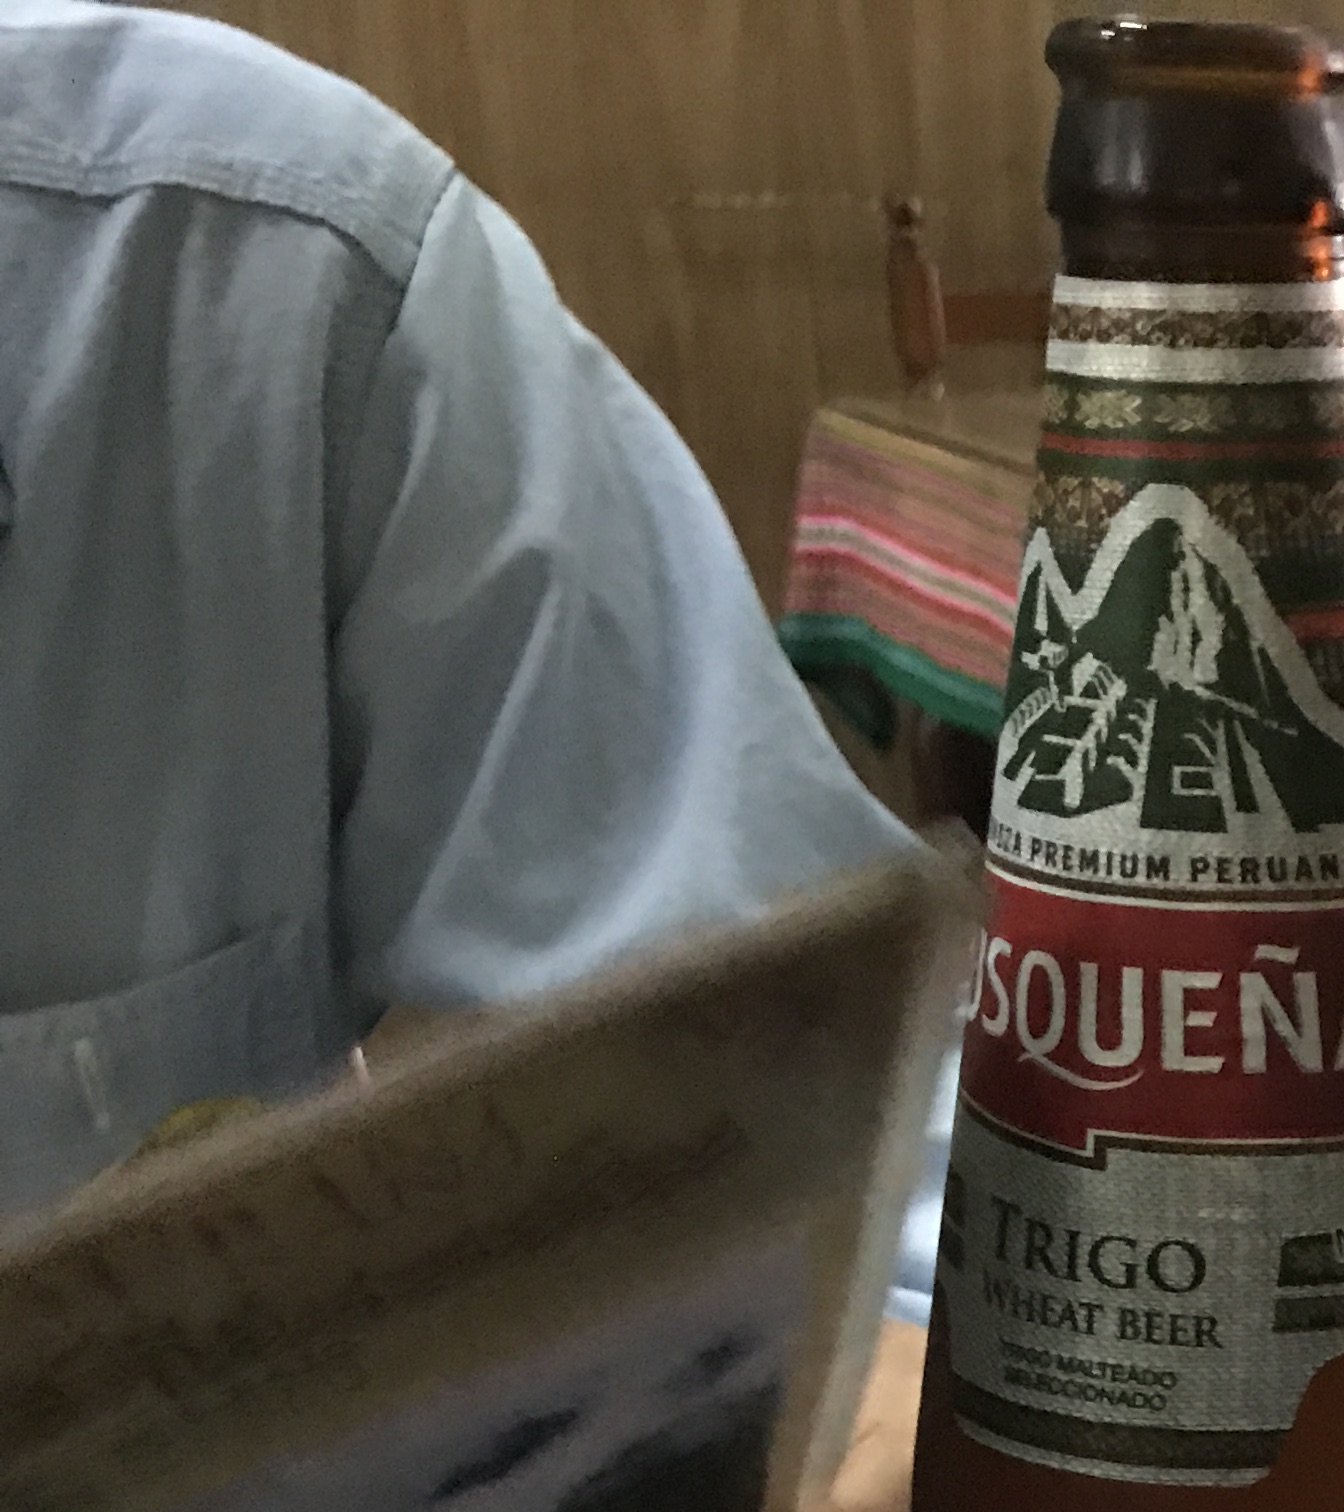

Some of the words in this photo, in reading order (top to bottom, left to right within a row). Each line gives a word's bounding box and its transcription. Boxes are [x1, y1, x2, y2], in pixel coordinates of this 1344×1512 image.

[1031, 836, 1170, 882] PREMIUM
[992, 1195, 1206, 1294] TRIGO
[983, 1268, 1104, 1336] WHEAT
[1117, 1305, 1224, 1349] BEER
